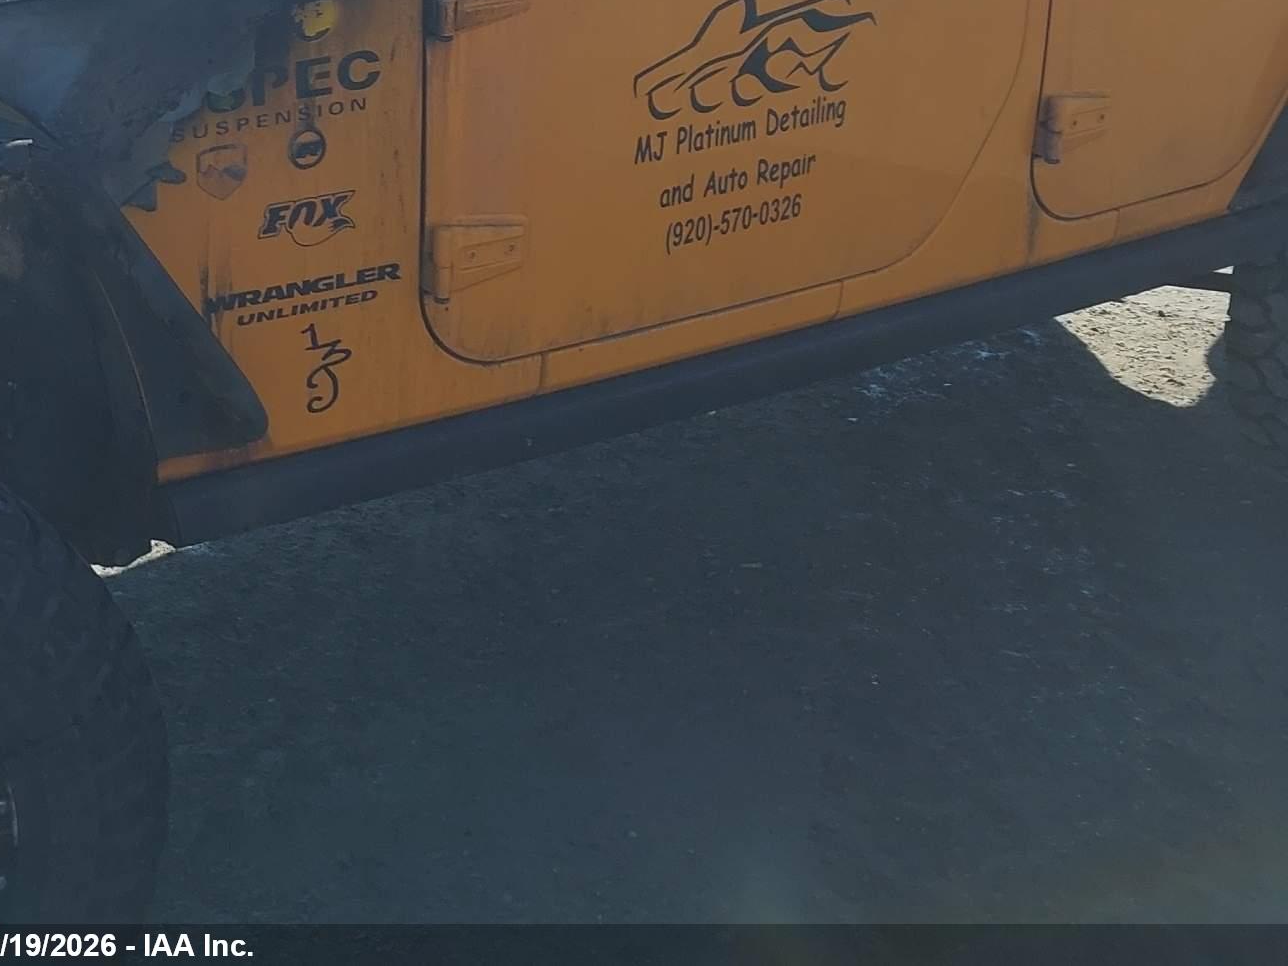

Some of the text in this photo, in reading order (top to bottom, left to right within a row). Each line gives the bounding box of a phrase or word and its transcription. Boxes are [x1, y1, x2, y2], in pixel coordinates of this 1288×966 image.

[170, 97, 368, 143] SUSPENSION
[634, 96, 848, 165] MJ Platinum Detailing
[659, 153, 816, 208] and Auto Repair
[257, 190, 356, 239] FOX
[665, 193, 803, 255] (920)-570-0326
[205, 262, 402, 314] WRANGLER
[237, 289, 379, 326] UNLIMITED
